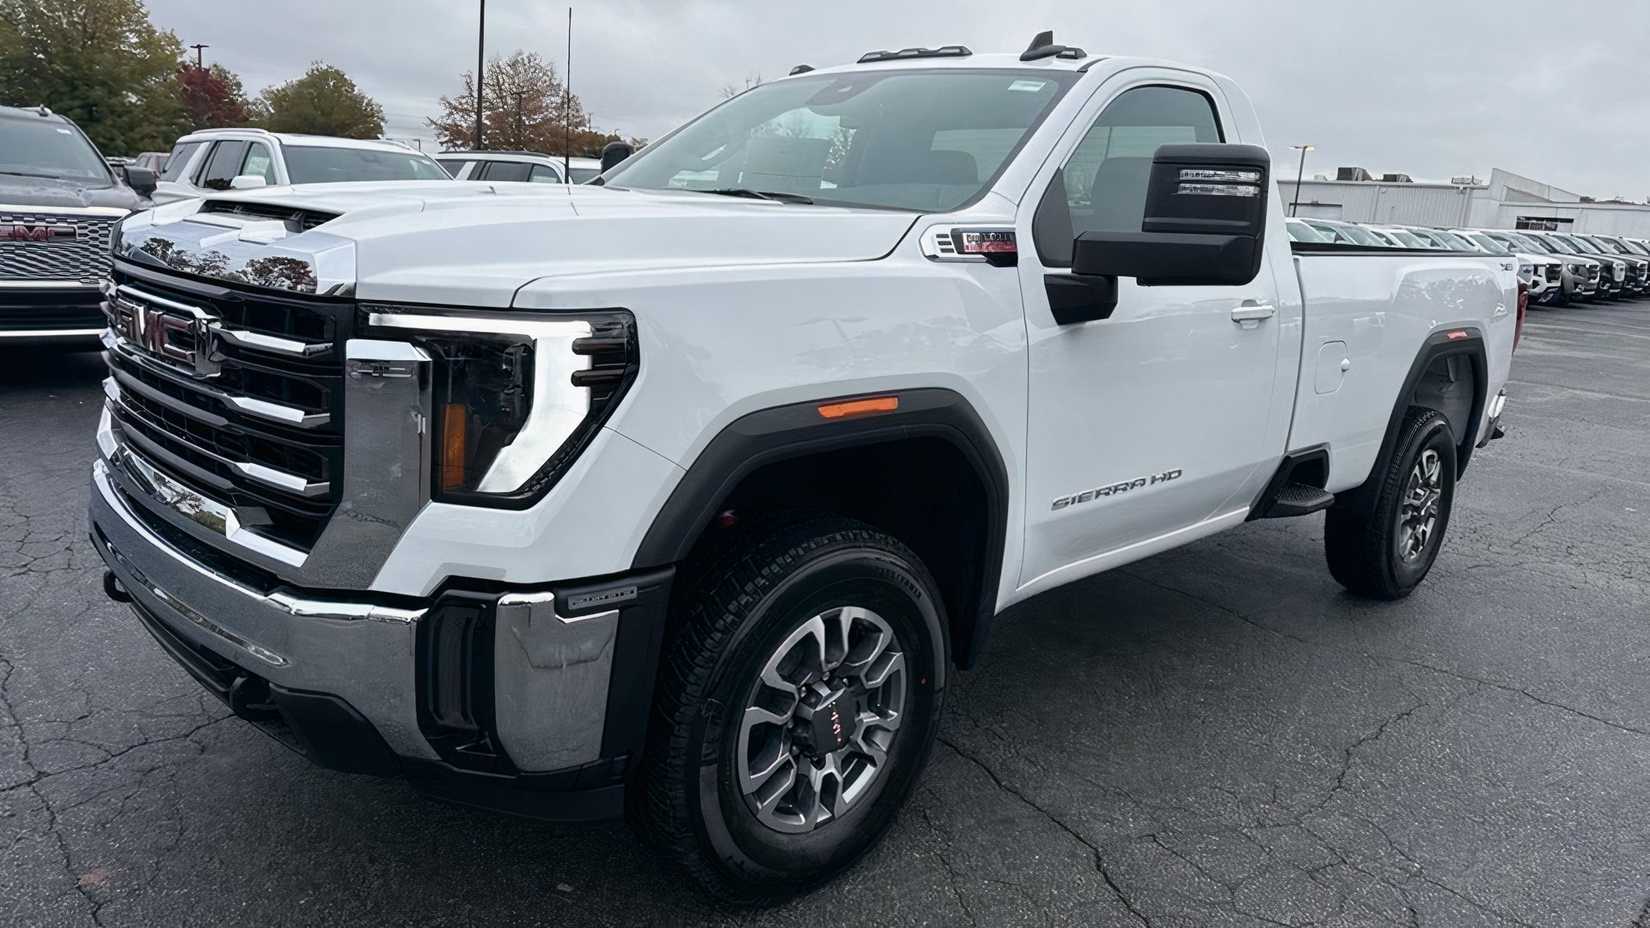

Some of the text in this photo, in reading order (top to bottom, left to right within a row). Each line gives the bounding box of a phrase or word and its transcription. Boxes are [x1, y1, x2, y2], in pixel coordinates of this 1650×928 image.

[115, 298, 196, 366] GMC
[1051, 469, 1183, 511] SIERRA HD
